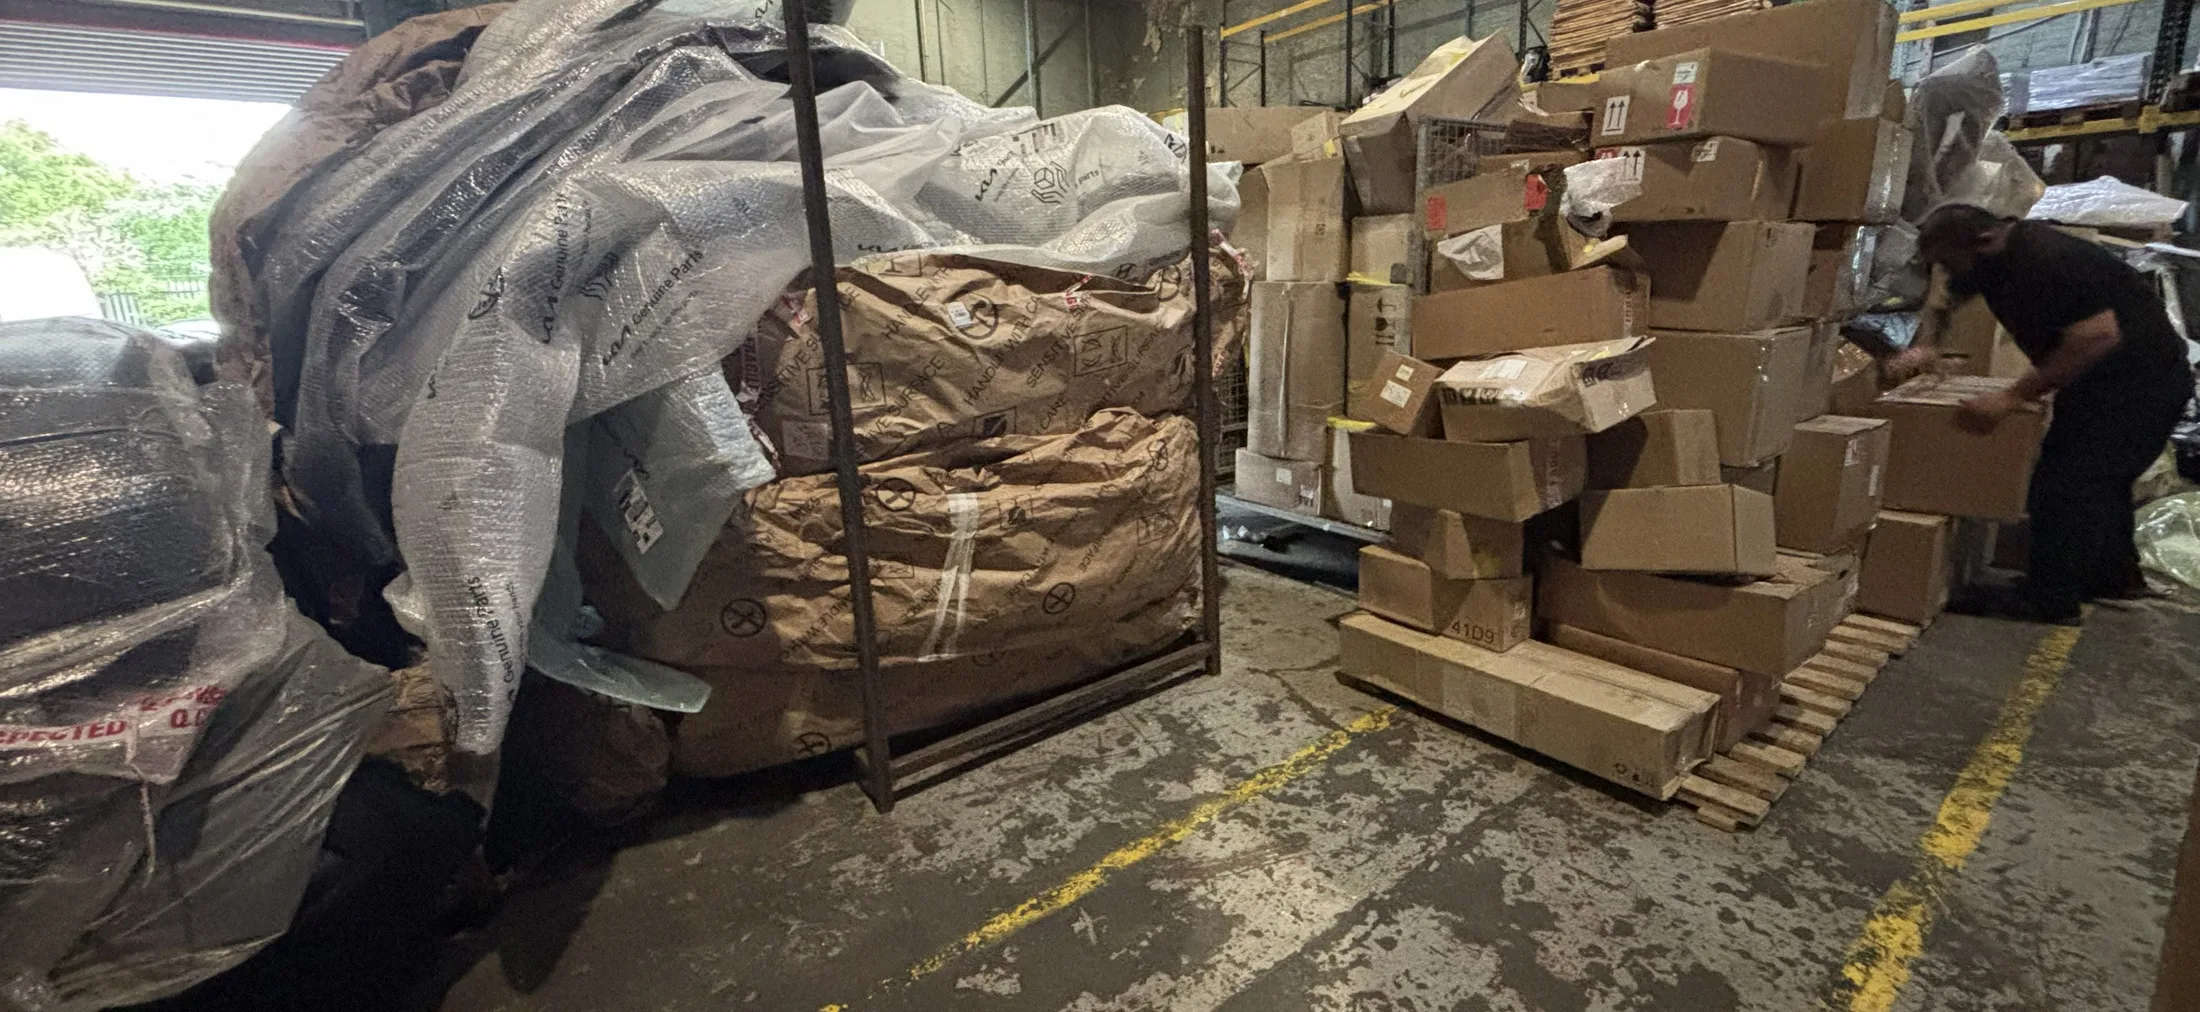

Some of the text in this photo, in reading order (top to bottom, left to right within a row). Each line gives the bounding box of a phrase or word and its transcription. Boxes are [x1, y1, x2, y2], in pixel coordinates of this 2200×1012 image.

[632, 278, 674, 325] Genuine
[670, 250, 704, 281] Parts
[1004, 315, 1033, 352] WITH
[1025, 293, 1044, 314] CA
[1026, 322, 1079, 388] SENSITIVE
[487, 619, 514, 683] Genuine
[1451, 621, 1494, 644] 41D9
